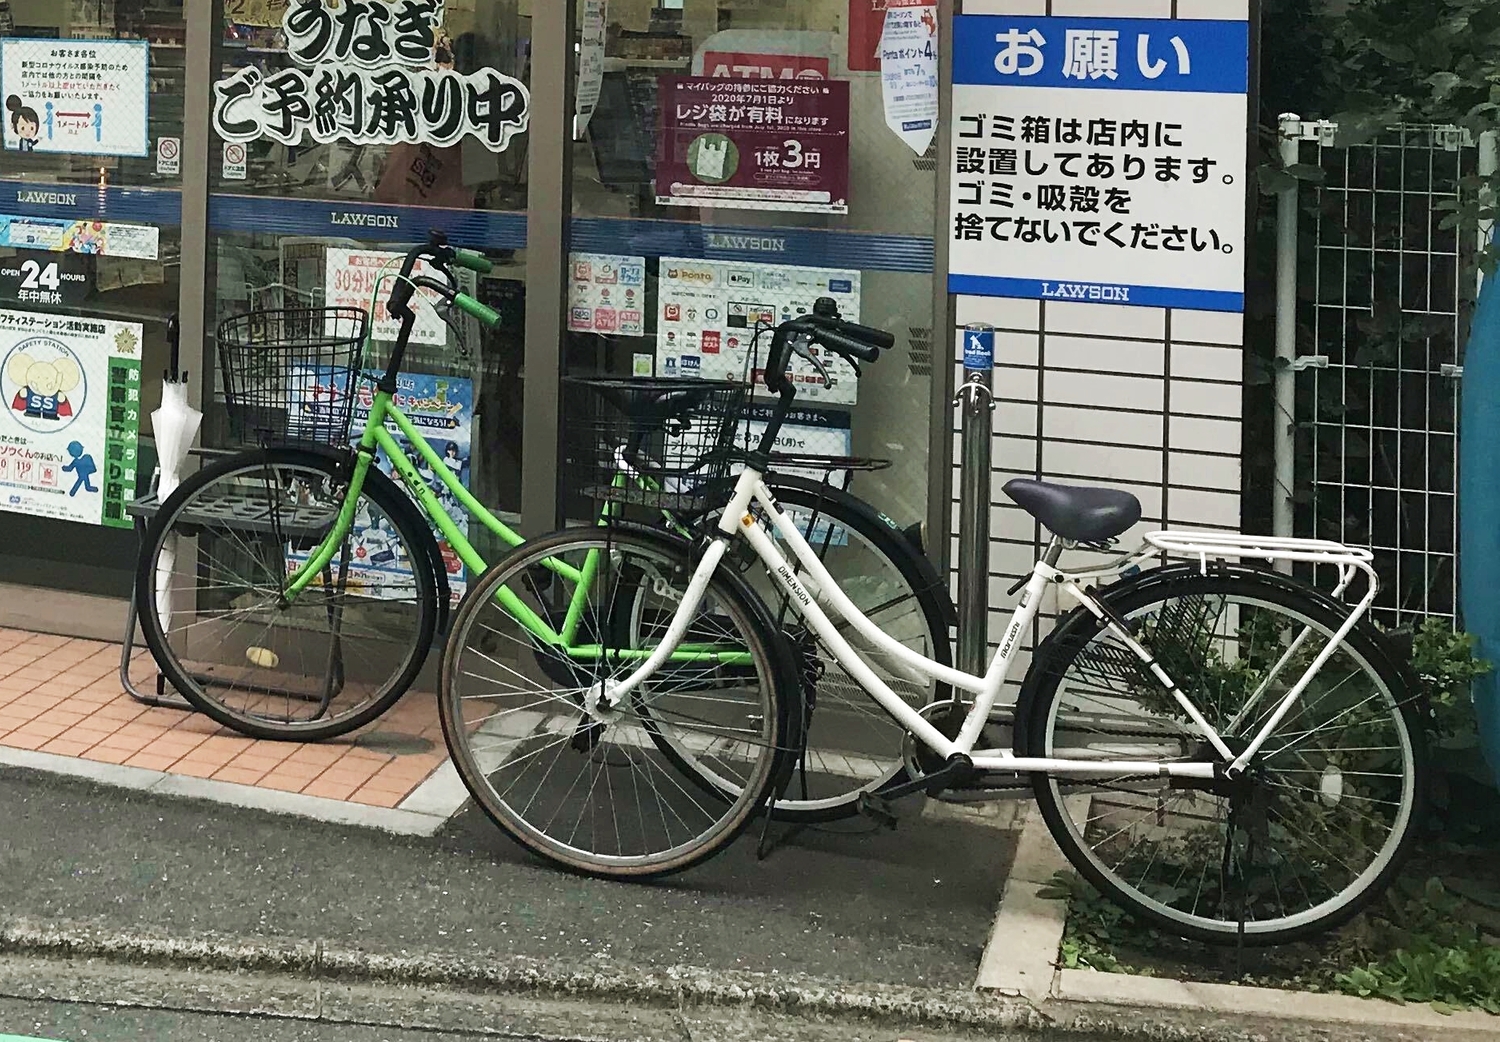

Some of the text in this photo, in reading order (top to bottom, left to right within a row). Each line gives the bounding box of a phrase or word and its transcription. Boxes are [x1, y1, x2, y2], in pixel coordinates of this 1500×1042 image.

[50, 48, 97, 59] お客さま各位
[993, 27, 1191, 82] お願い
[21, 60, 129, 71] 新型コロナウイルス感染予防のため
[21, 70, 102, 81] 店内では他の方との間隔を
[686, 82, 820, 94] マイバッグの持参にご協力ください
[217, 69, 527, 144] ご予約承り中
[711, 94, 794, 104] 2020年7月1日より
[676, 104, 829, 126] レジ袋が有料になります
[57, 120, 90, 128] 1メートル
[958, 114, 1183, 148] ゴミ箱は店内に
[754, 139, 821, 168] 1枚3円
[956, 146, 1234, 186] 設置してあります。
[16, 190, 76, 206] LAWSON
[957, 180, 1132, 215] ゴミ・吸殻を
[330, 211, 399, 228] LAWSON
[707, 233, 785, 251] LAWSON
[954, 212, 1234, 255] 捨てないでください。
[0, 259, 86, 290] OPEN 24 HOURS
[681, 270, 712, 281] Ponta
[736, 275, 751, 284] Pay
[17, 289, 62, 304] 年中無休
[1041, 282, 1130, 302] LAWSON
[620, 312, 639, 320] ATM
[18, 339, 71, 357] SAFETY STATION
[30, 395, 54, 410] SS
[16, 461, 31, 471] 119
[777, 565, 812, 607] DIMENSION
